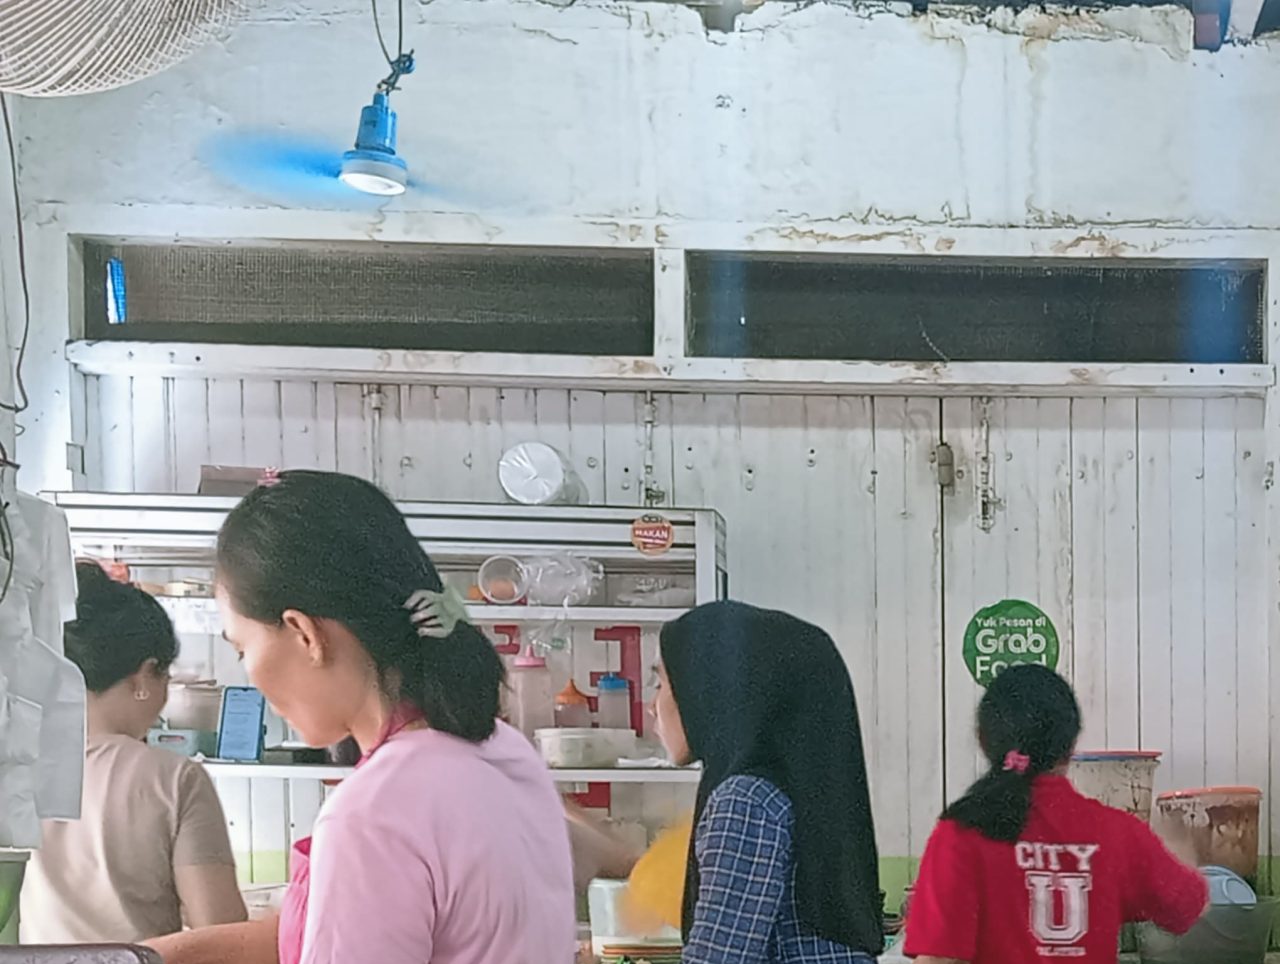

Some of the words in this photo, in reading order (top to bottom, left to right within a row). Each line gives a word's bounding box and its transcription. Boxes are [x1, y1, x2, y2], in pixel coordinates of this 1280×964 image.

[1035, 616, 1046, 627] di
[975, 627, 1046, 655] Grab
[1015, 841, 1099, 871] CITY
[1025, 871, 1092, 944] U
